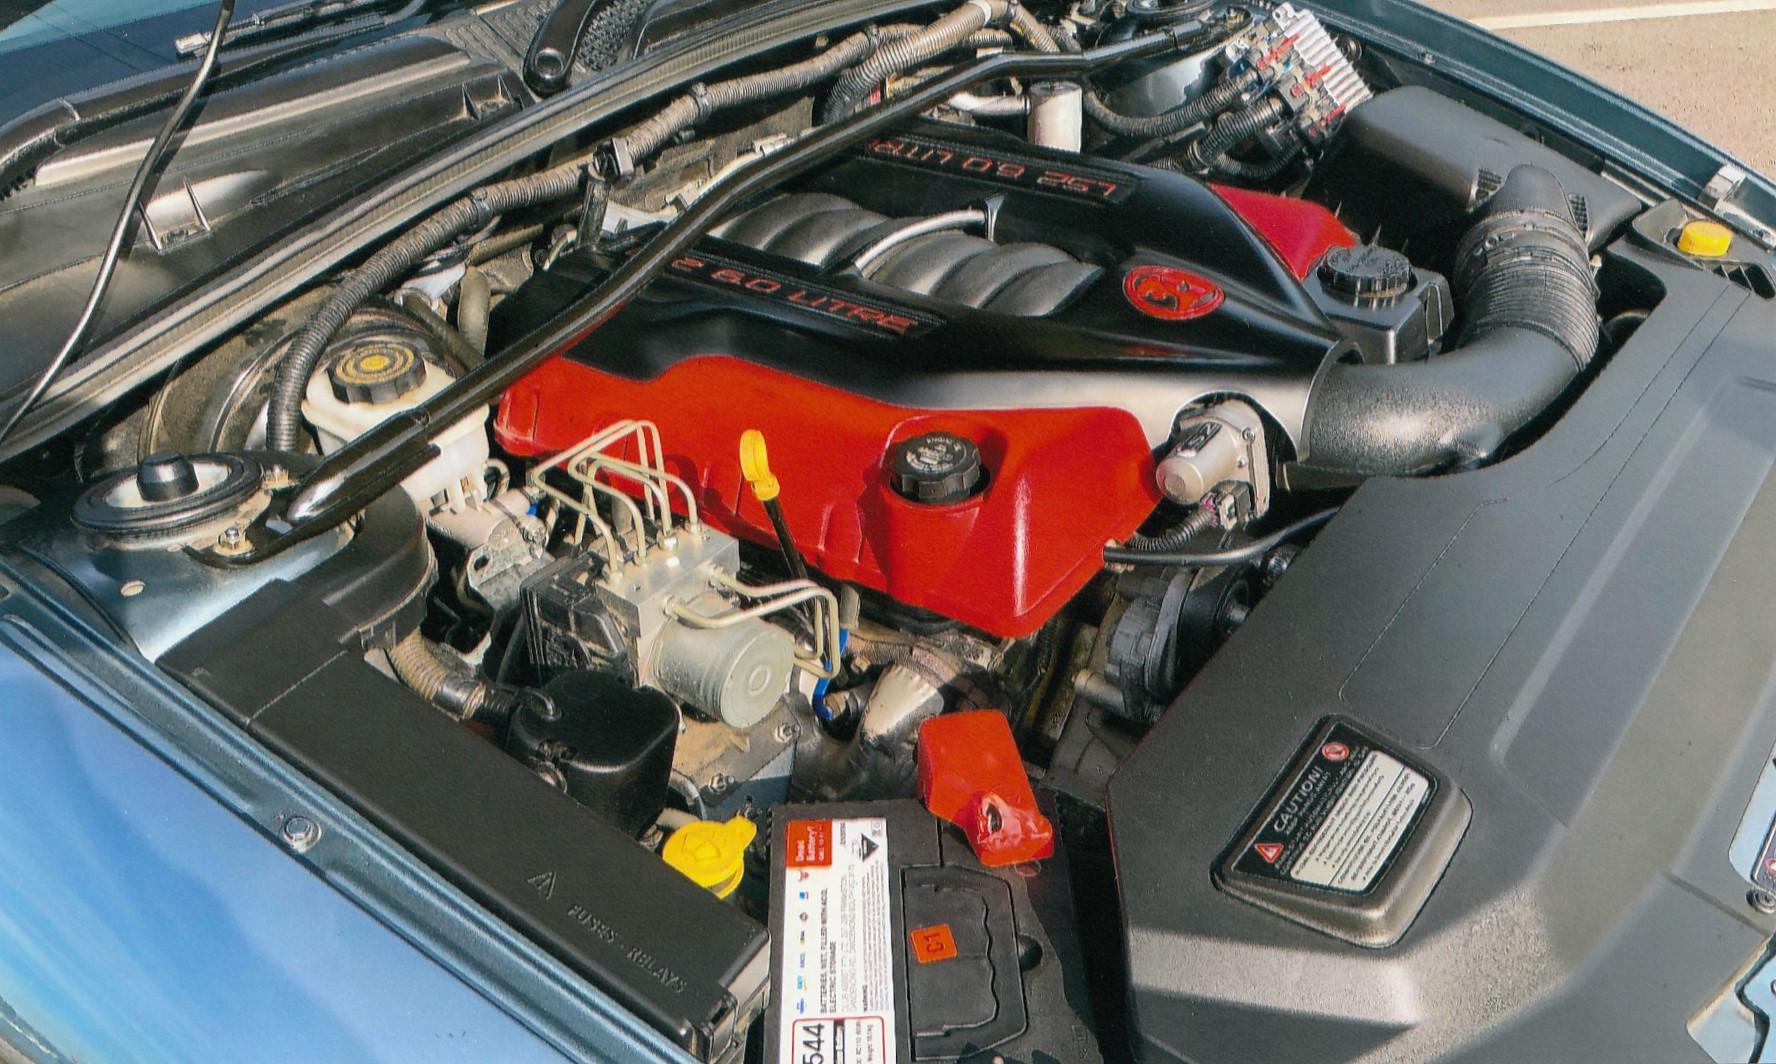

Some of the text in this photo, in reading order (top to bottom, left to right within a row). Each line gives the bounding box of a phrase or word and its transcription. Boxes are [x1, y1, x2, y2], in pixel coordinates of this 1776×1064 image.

[1037, 171, 1117, 197] LS2
[787, 290, 918, 334] LITRE
[1273, 766, 1323, 832] CAUTION!
[795, 840, 805, 862] Dead
[806, 825, 818, 861] Battery?
[567, 904, 618, 944] FUSES
[626, 947, 688, 994] RELAYS
